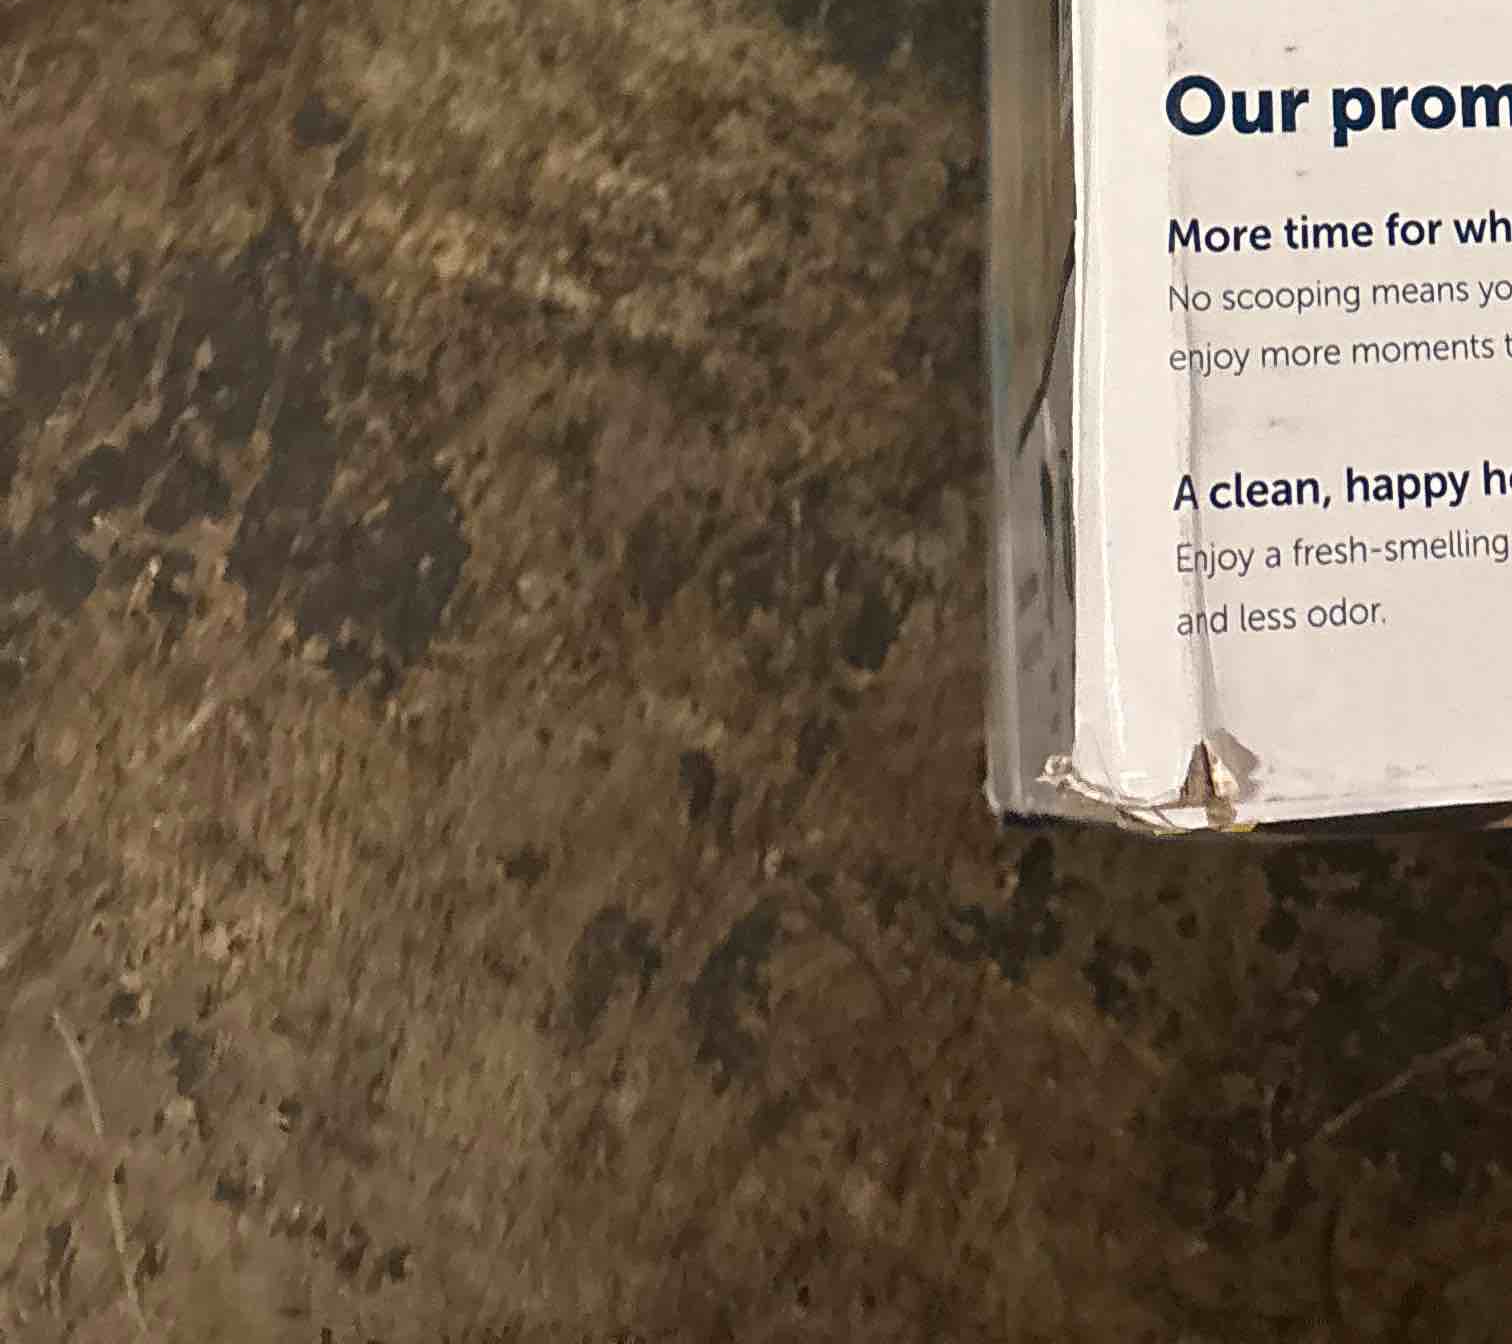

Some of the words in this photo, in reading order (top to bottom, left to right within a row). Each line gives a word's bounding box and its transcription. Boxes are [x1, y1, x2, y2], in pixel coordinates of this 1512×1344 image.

[1165, 74, 1310, 136] Our
[1168, 218, 1272, 254] More
[1285, 215, 1374, 248] time
[1386, 212, 1442, 246] for
[1169, 284, 1212, 312] No
[1222, 279, 1361, 314] scooping
[1371, 280, 1470, 306] means
[1169, 342, 1251, 378] enjoy
[1261, 342, 1341, 368] more
[1351, 334, 1496, 365] moments
[1174, 475, 1198, 511] A
[1209, 469, 1333, 511] clean,
[1346, 467, 1470, 509] happy
[1177, 543, 1255, 580] Enjoy
[1265, 546, 1281, 570] a
[1293, 529, 1511, 564] fresh-smelling
[1177, 605, 1229, 636] and
[1239, 603, 1297, 630] less
[1306, 598, 1388, 627] odor.
